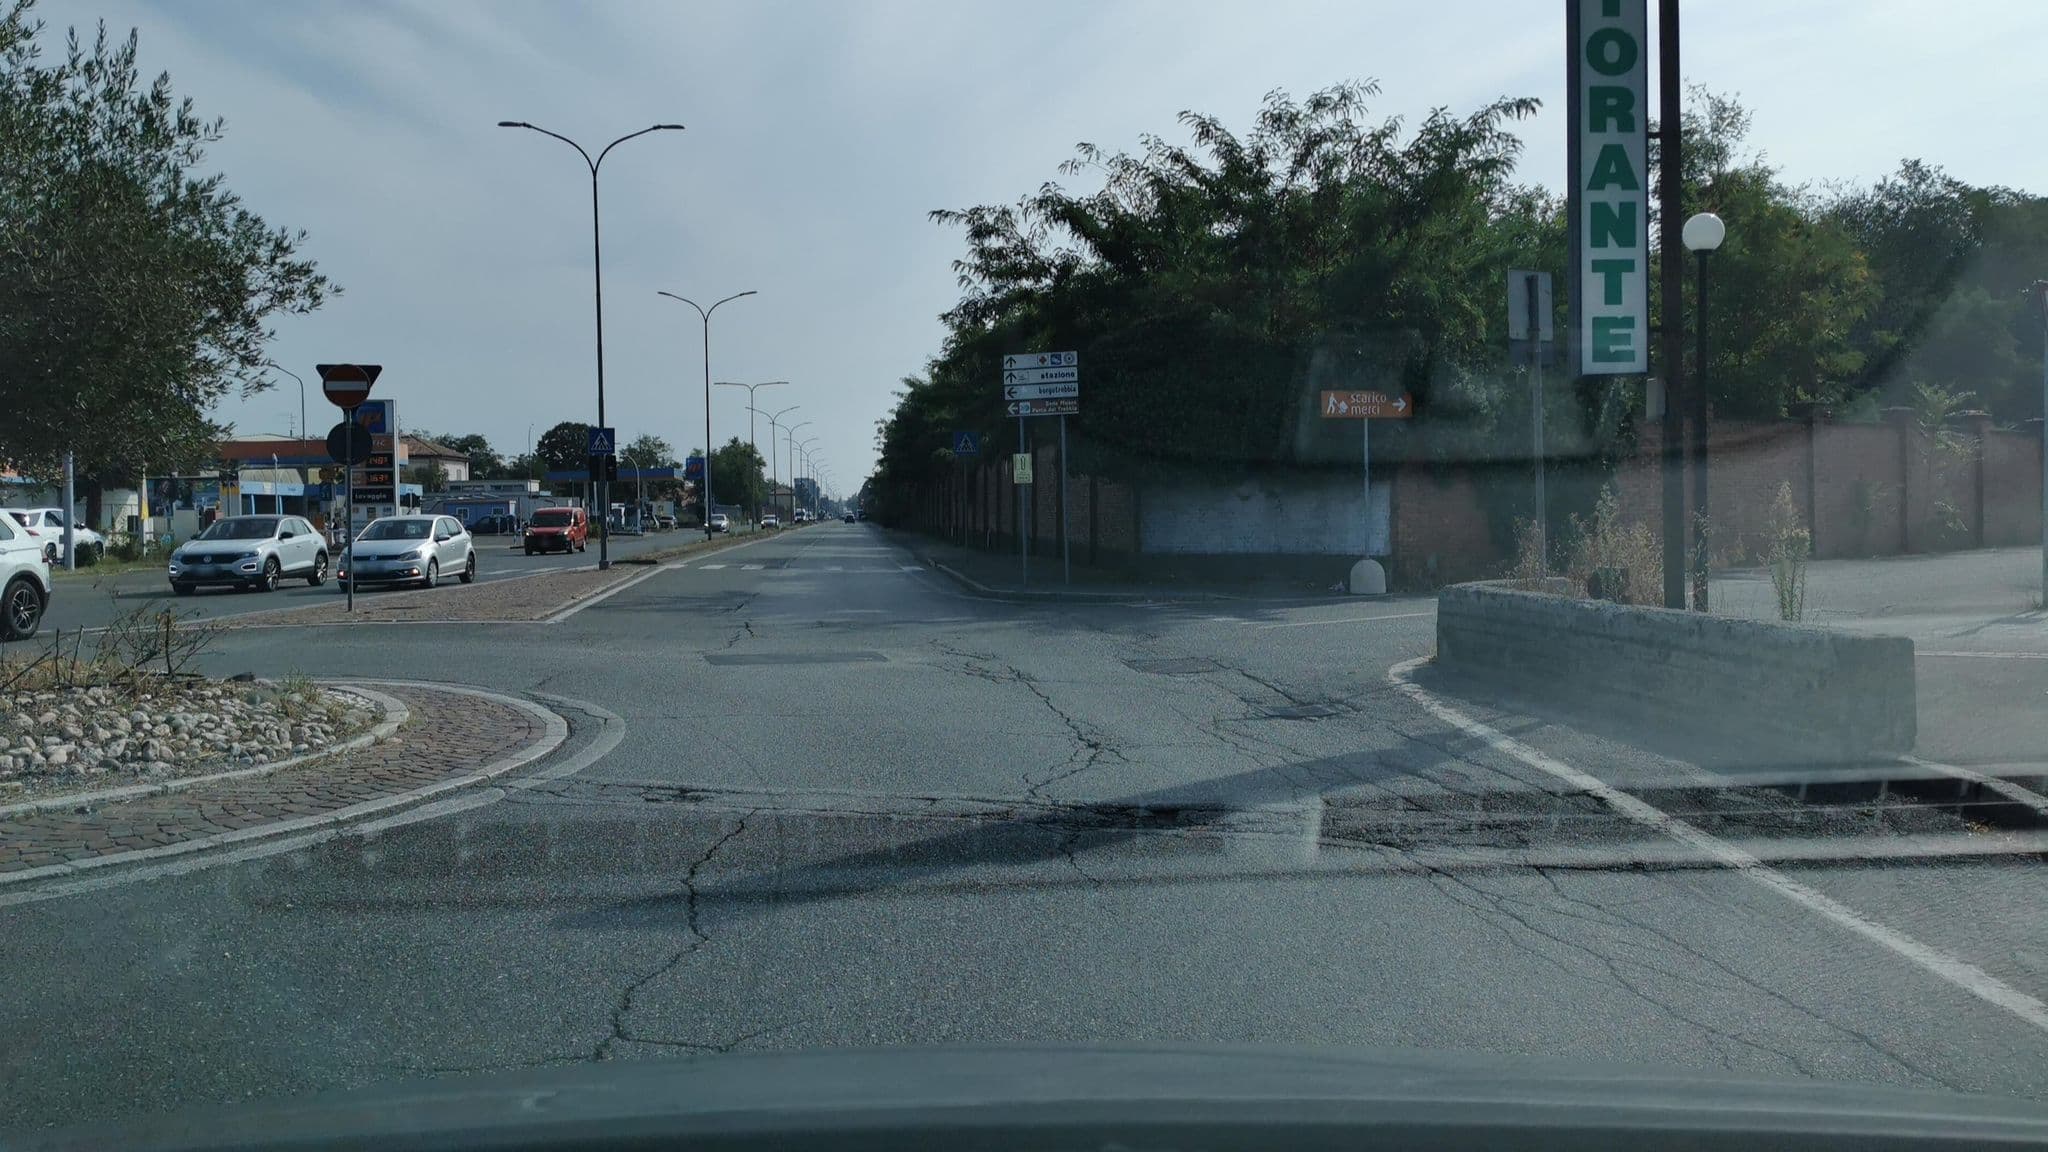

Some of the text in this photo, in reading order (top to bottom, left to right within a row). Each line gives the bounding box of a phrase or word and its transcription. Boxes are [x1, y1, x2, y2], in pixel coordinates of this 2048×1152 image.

[1041, 371, 1075, 379] stazione
[1350, 391, 1387, 404] scarico
[1351, 403, 1380, 415] merci
